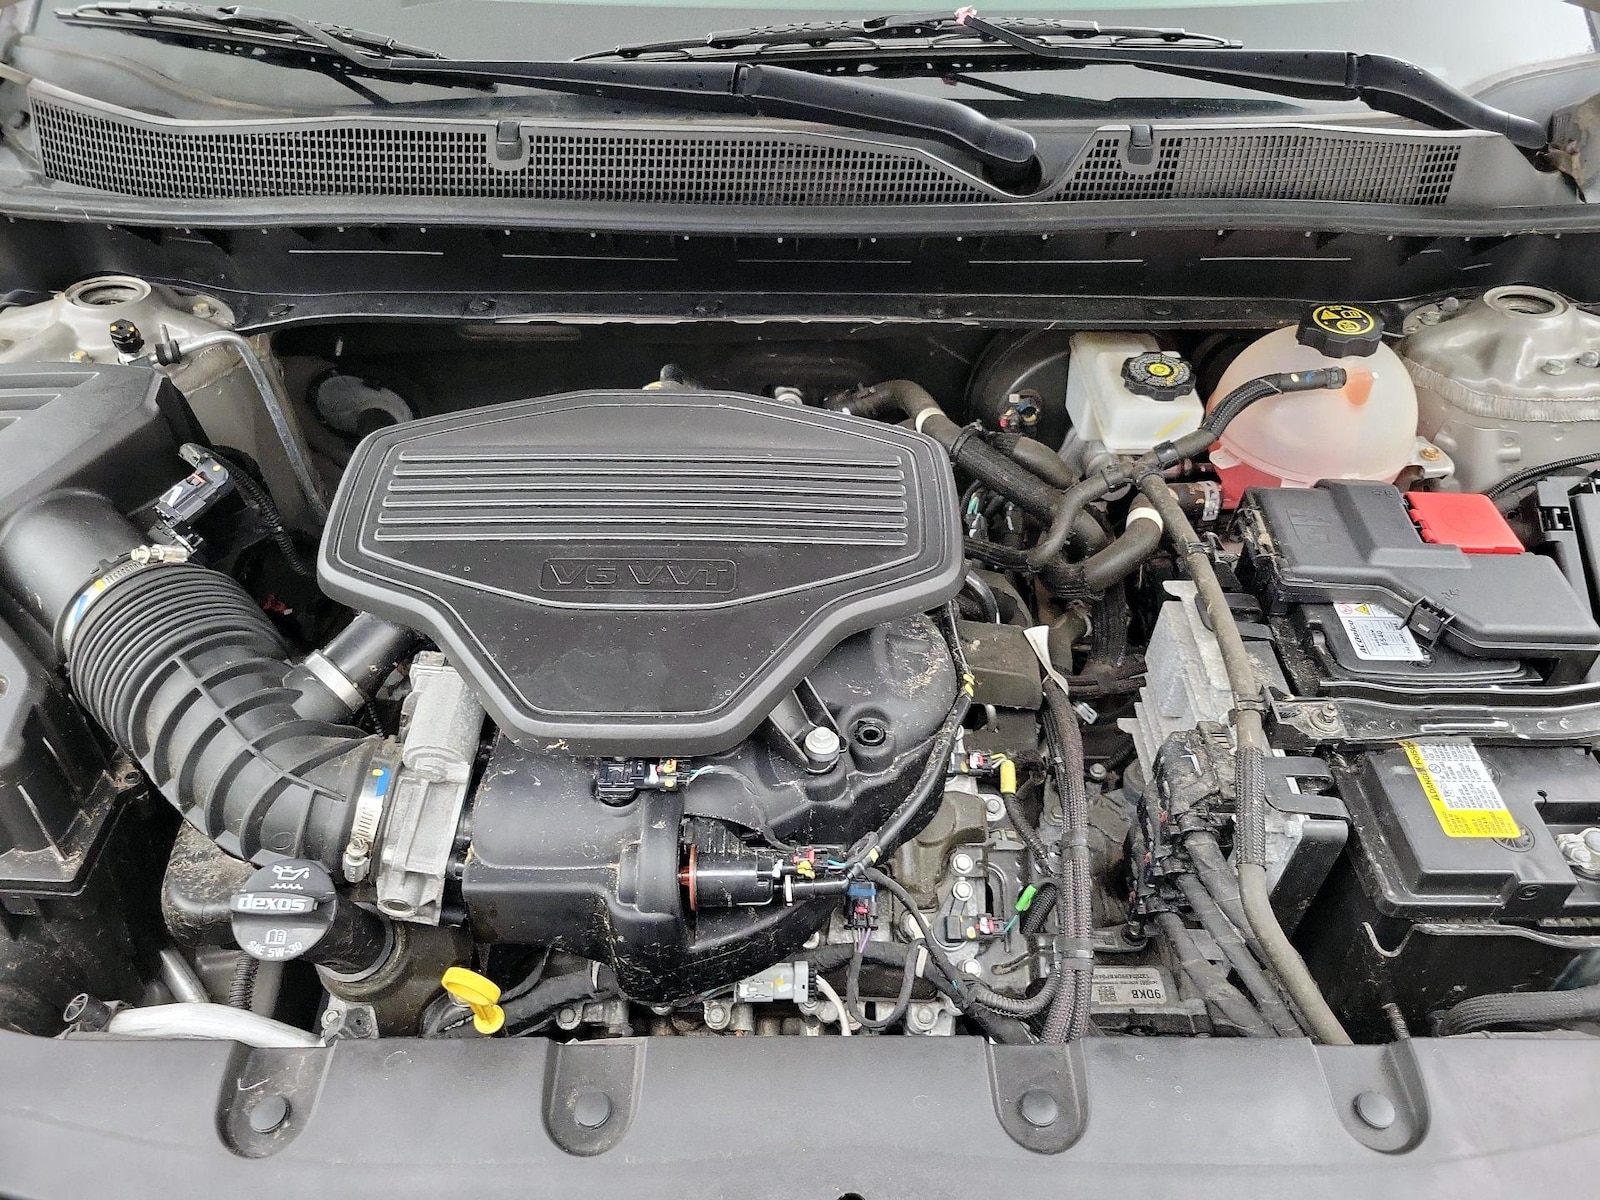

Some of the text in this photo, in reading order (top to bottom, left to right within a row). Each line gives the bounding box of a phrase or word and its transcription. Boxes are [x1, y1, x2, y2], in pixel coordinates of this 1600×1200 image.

[550, 563, 728, 587] V6 VVT
[237, 893, 309, 912] dexos
[246, 940, 303, 958] SAE 5W-30
